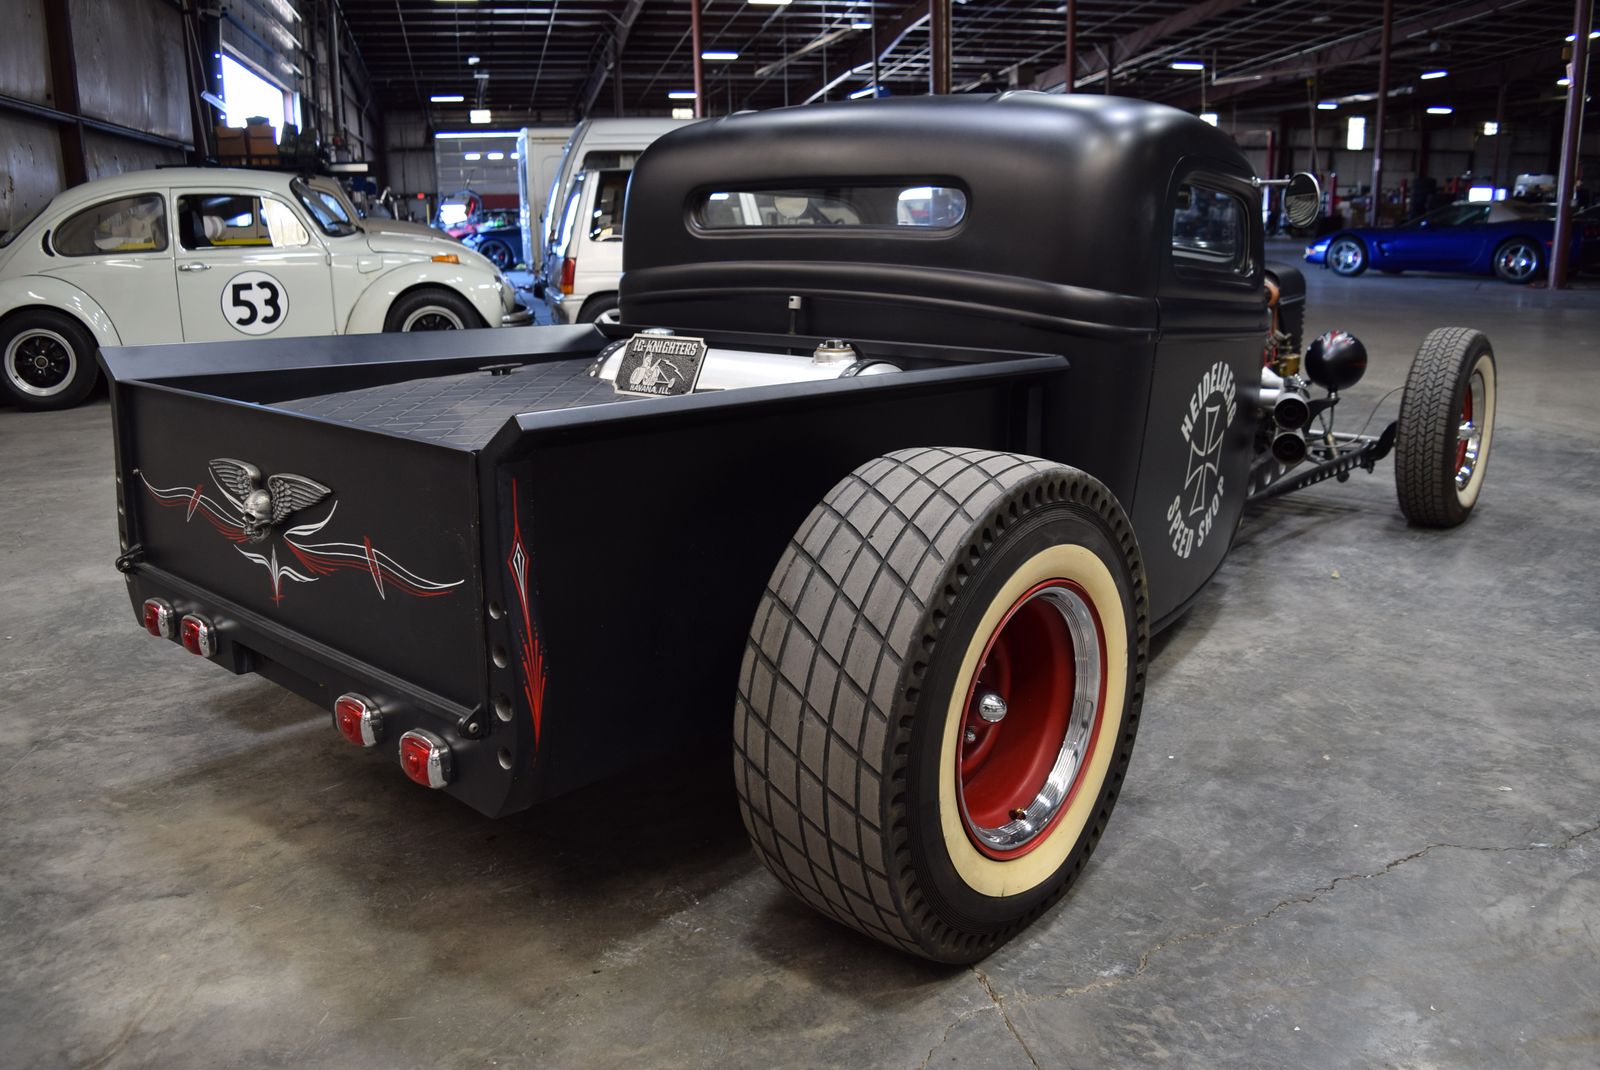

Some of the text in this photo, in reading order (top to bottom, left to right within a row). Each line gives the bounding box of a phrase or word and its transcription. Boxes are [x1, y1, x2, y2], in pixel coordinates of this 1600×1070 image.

[232, 281, 281, 326] 53
[1181, 361, 1237, 442] HEIDELBERG
[1167, 475, 1224, 559] SPEED SHOP
